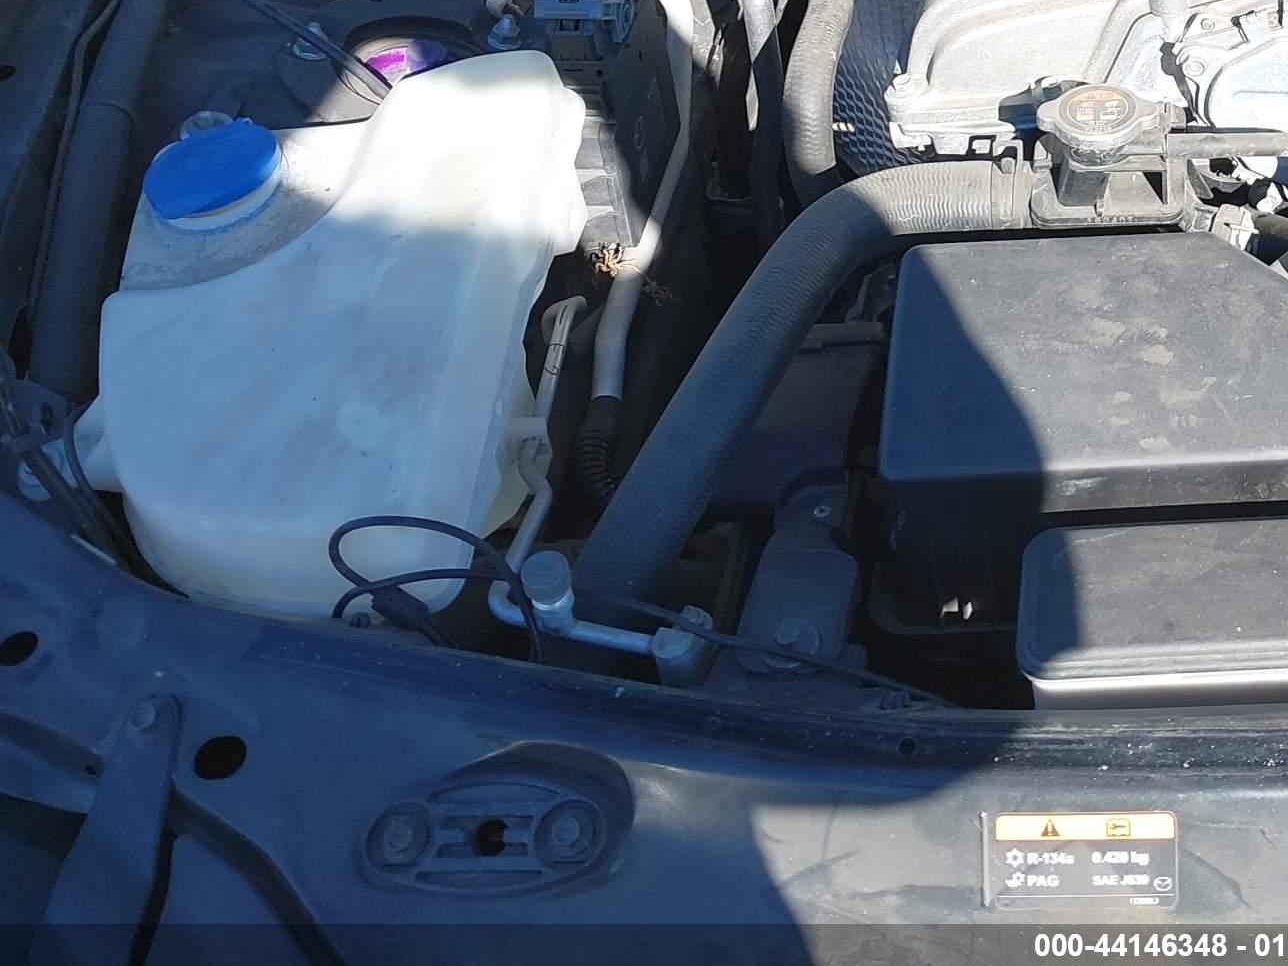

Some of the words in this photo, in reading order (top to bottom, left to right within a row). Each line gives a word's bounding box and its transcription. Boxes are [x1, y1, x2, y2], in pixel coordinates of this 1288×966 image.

[1027, 852, 1075, 865] R-134a
[1131, 851, 1150, 866] kg
[1027, 875, 1061, 887] PAG
[1092, 875, 1118, 886] SAE
